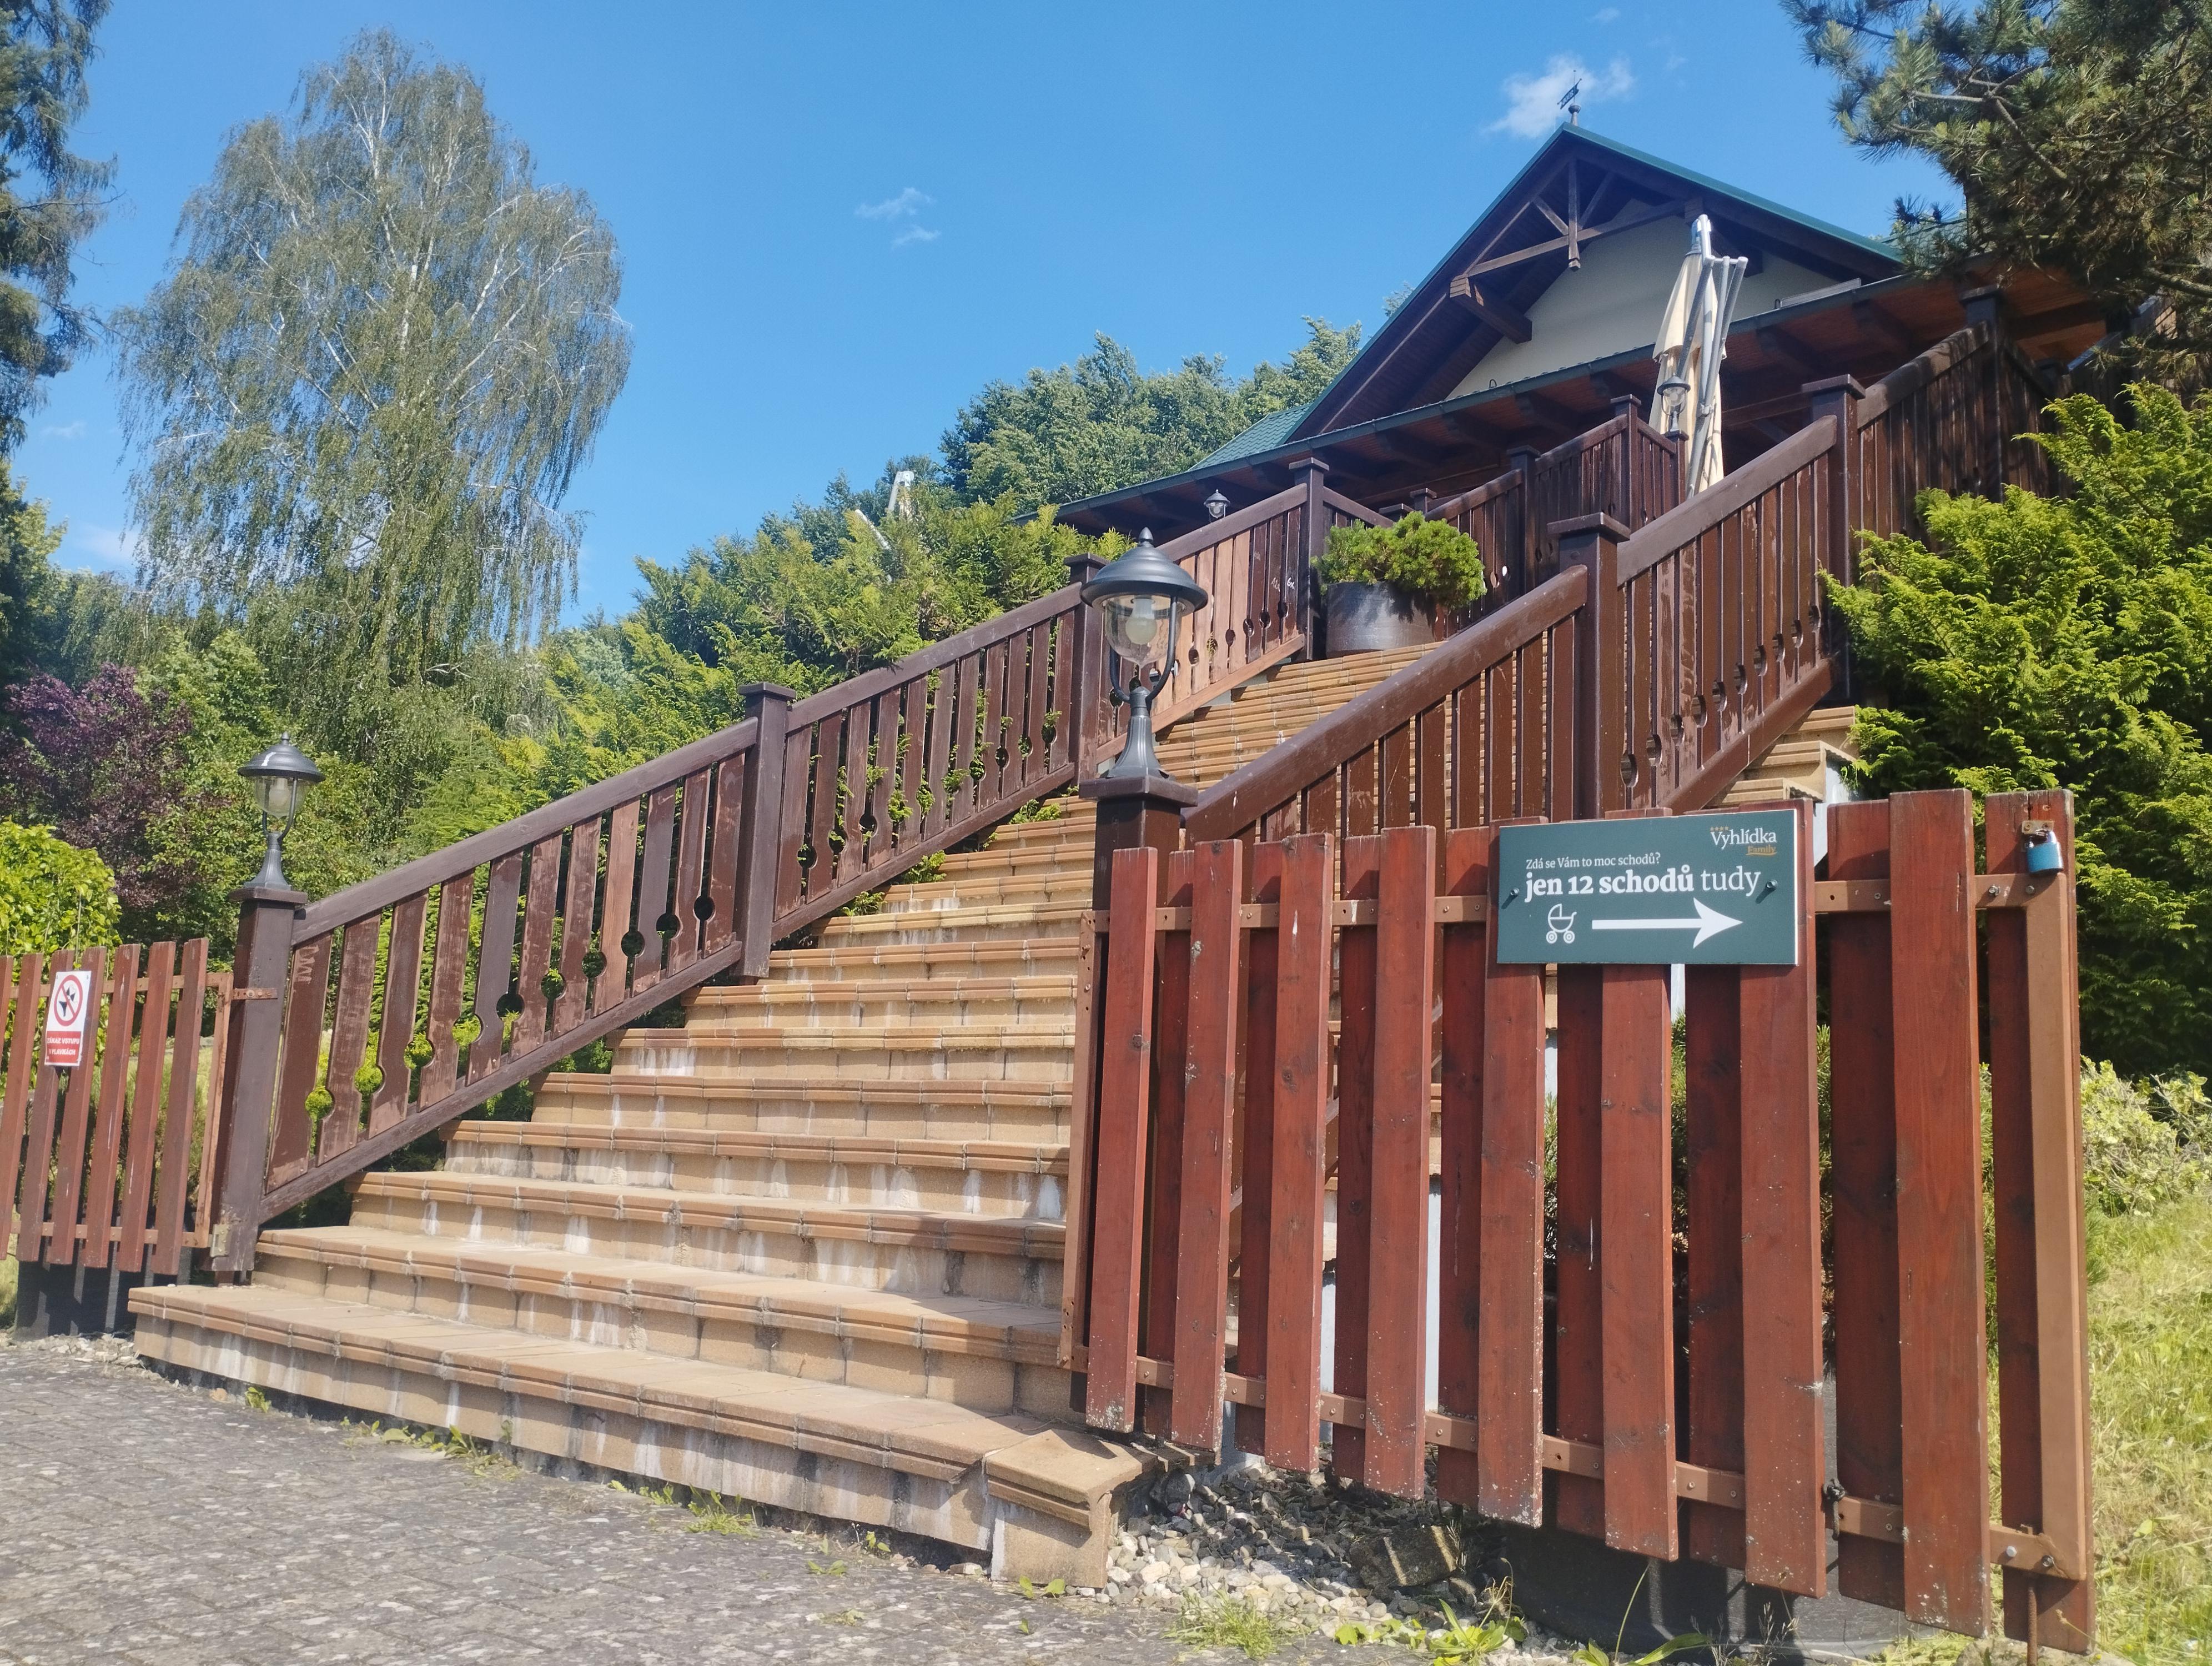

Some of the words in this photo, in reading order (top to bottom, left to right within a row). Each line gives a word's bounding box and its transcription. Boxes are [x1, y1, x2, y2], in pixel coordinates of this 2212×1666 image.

[1710, 827, 1777, 850] Vyhlídka
[1747, 844, 1776, 855] Family
[1526, 857, 1544, 870] Zdá
[1545, 860, 1556, 868] se
[1557, 856, 1580, 867] Vám
[1582, 856, 1592, 867] to
[1594, 857, 1616, 866] moc
[1618, 851, 1661, 865] schodů?
[1525, 872, 1563, 902] jen
[1568, 876, 1593, 895] 12
[1600, 864, 1693, 894] schodů
[1701, 865, 1761, 896] tudy
